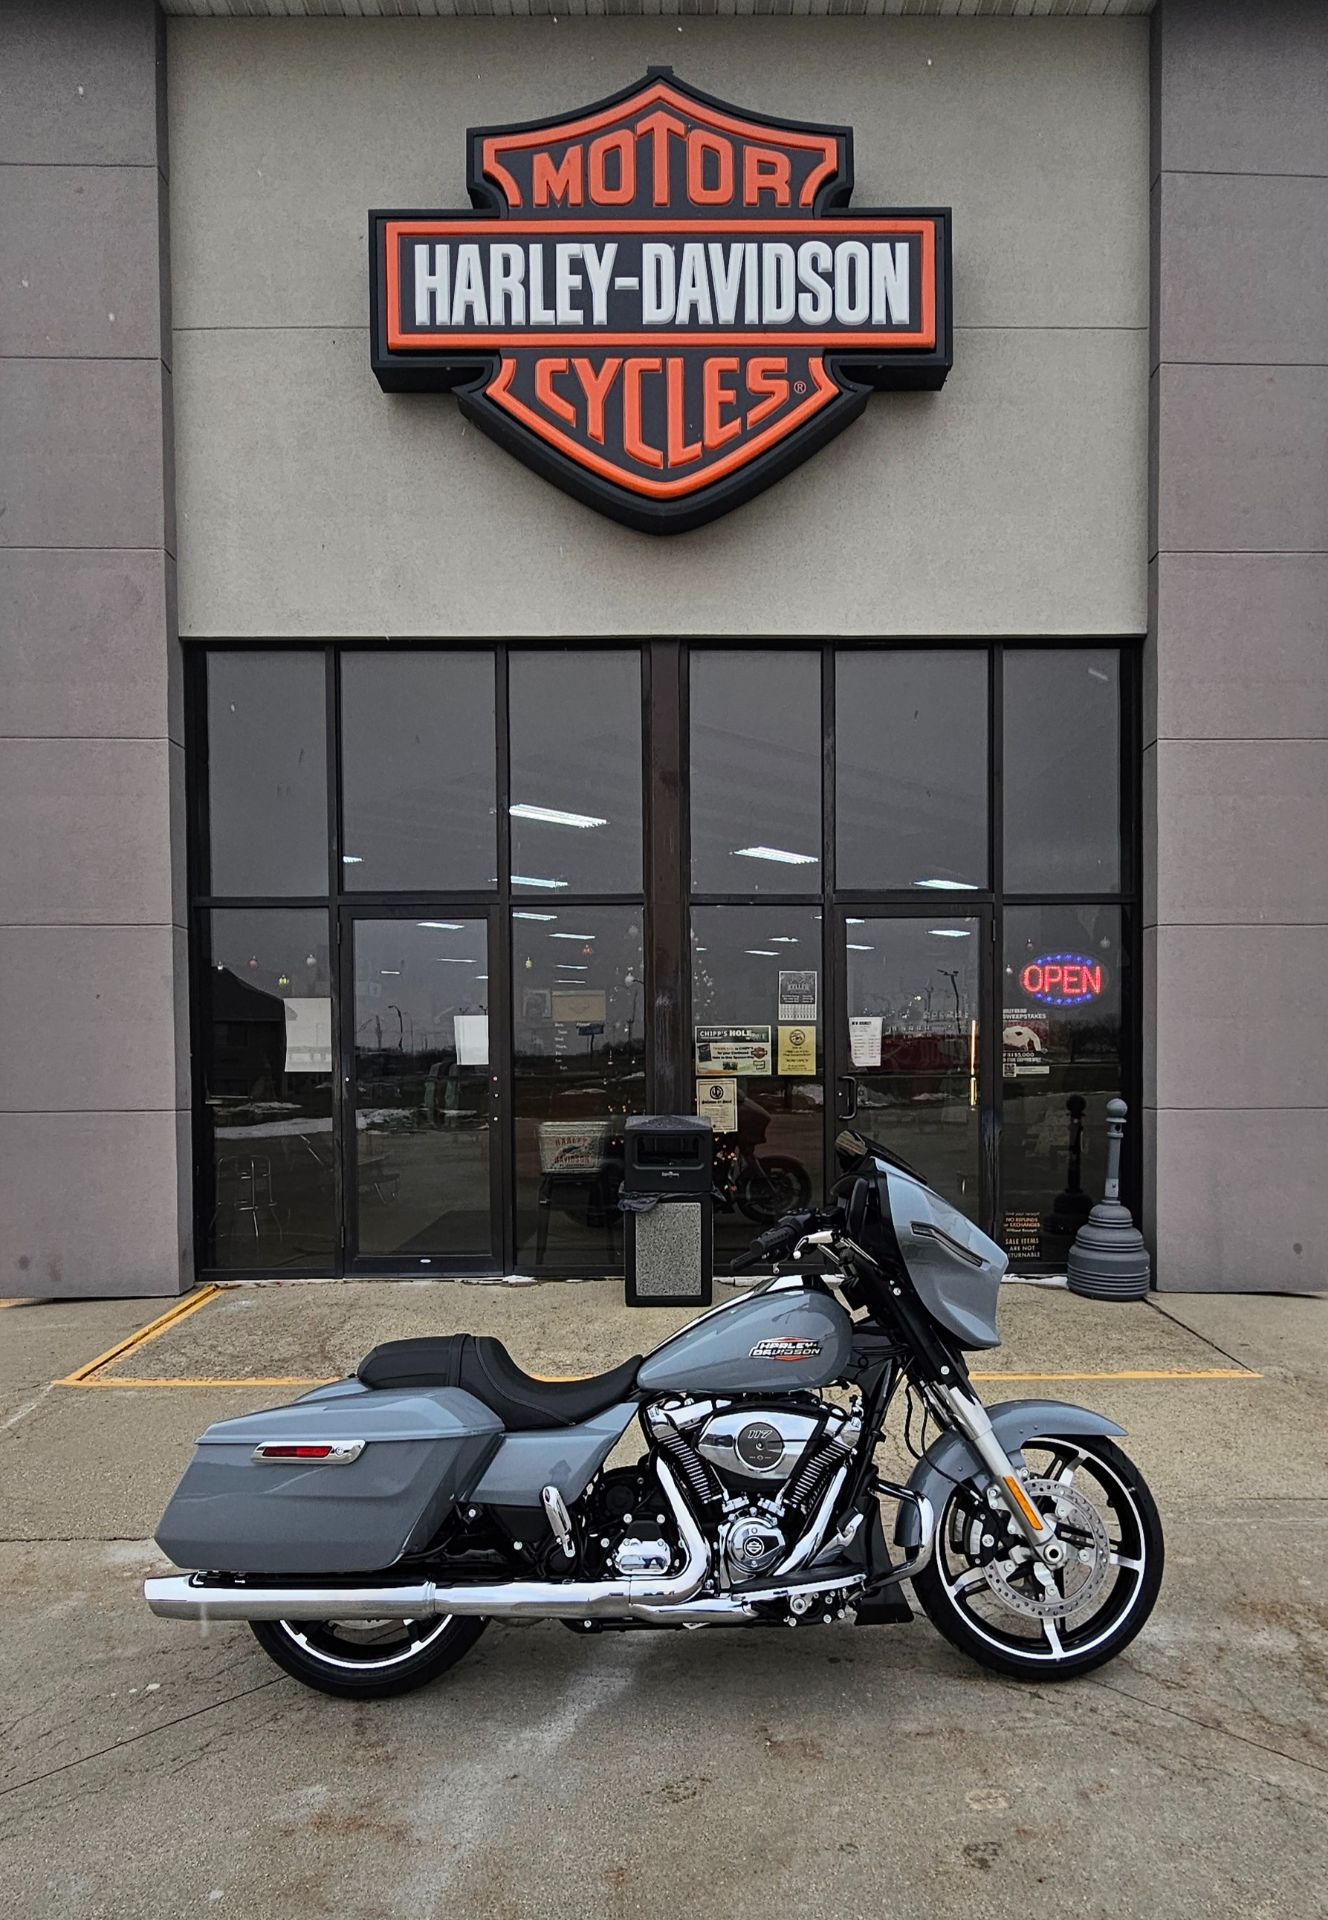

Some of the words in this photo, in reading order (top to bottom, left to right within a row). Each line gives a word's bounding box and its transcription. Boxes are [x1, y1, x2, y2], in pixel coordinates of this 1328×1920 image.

[532, 110, 792, 207] MOTOR
[413, 240, 911, 326] HARLEY-DAVIDSON
[534, 356, 790, 469] CYCLES
[1022, 963, 1102, 994] OPEN
[753, 1348, 821, 1356] DAVIDSON
[748, 1430, 773, 1439] 117
